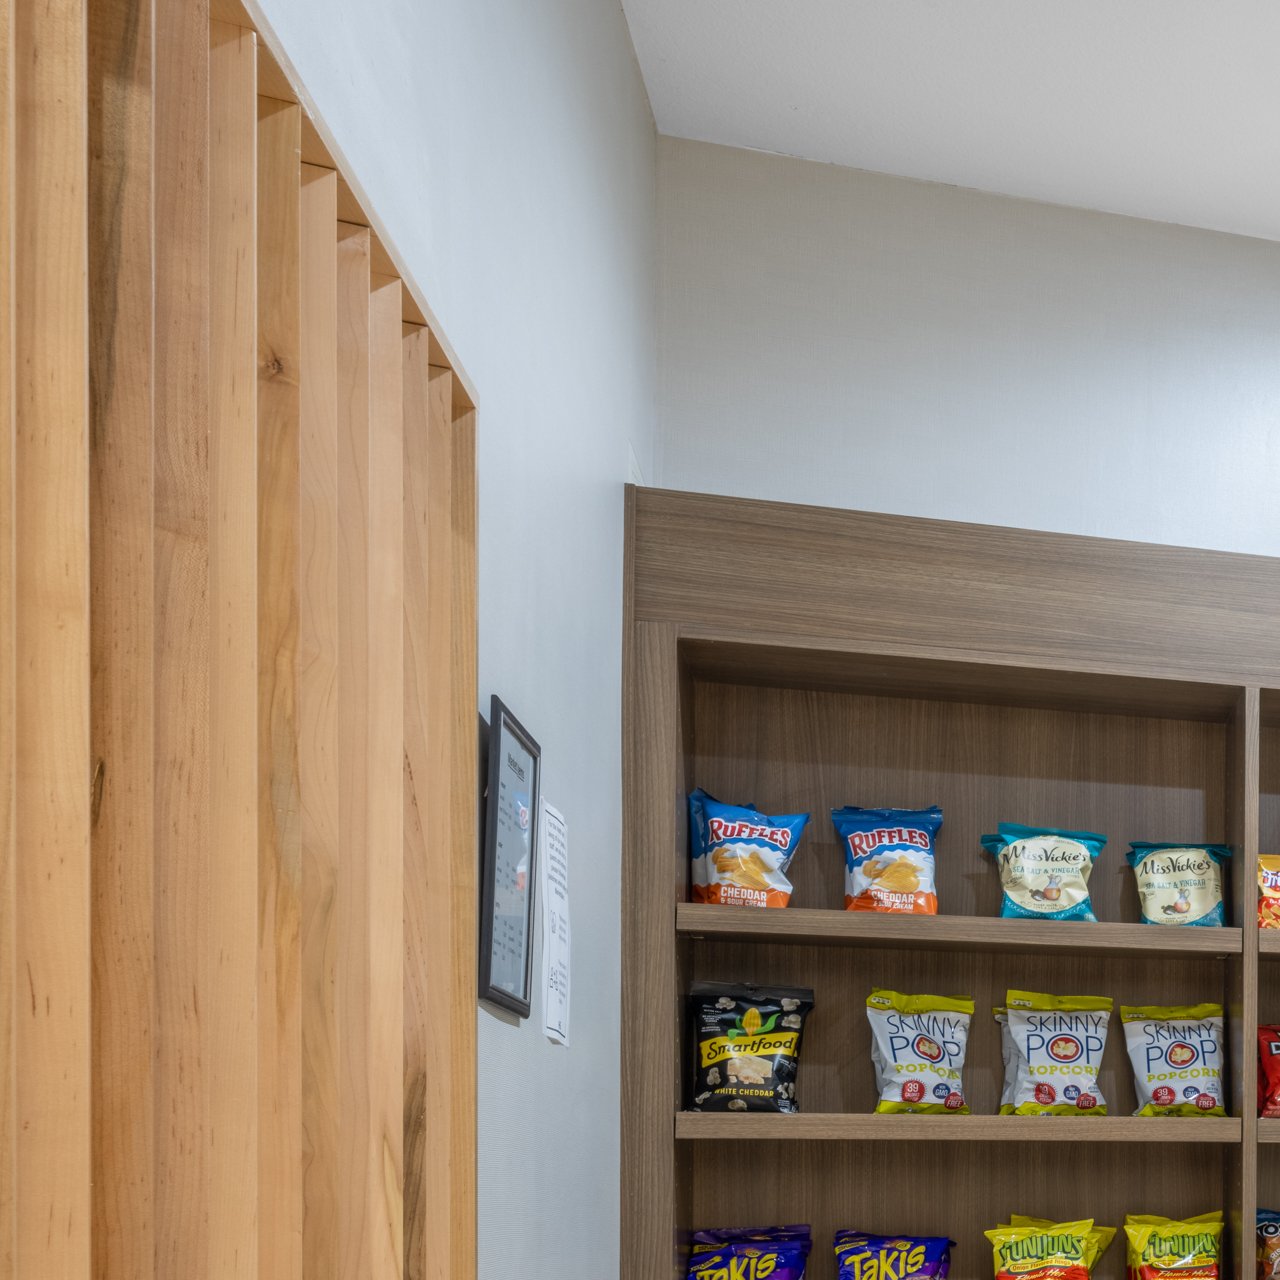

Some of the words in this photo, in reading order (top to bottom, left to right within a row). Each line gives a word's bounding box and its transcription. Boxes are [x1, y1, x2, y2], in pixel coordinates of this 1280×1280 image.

[708, 818, 791, 849] RUFFLES
[848, 827, 930, 859] RUFFLES
[1041, 846, 1089, 864] Vickie's
[1139, 859, 1171, 878] Miss
[1168, 854, 1213, 876] Vickie's
[720, 886, 767, 902] CHEDDAR
[871, 890, 915, 903] CHEDDAR
[1027, 1012, 1103, 1033] SKINNY
[1143, 1022, 1214, 1046] SKINNY
[706, 1037, 795, 1060] Smartfood
[889, 1033, 961, 1067] POP
[1027, 1033, 1103, 1064] POP
[1146, 1039, 1217, 1073] POP
[1147, 1069, 1220, 1082] POPCORN
[714, 1088, 737, 1096] WHITE
[739, 1088, 774, 1097] CHEDDAR
[907, 1083, 919, 1093] 39
